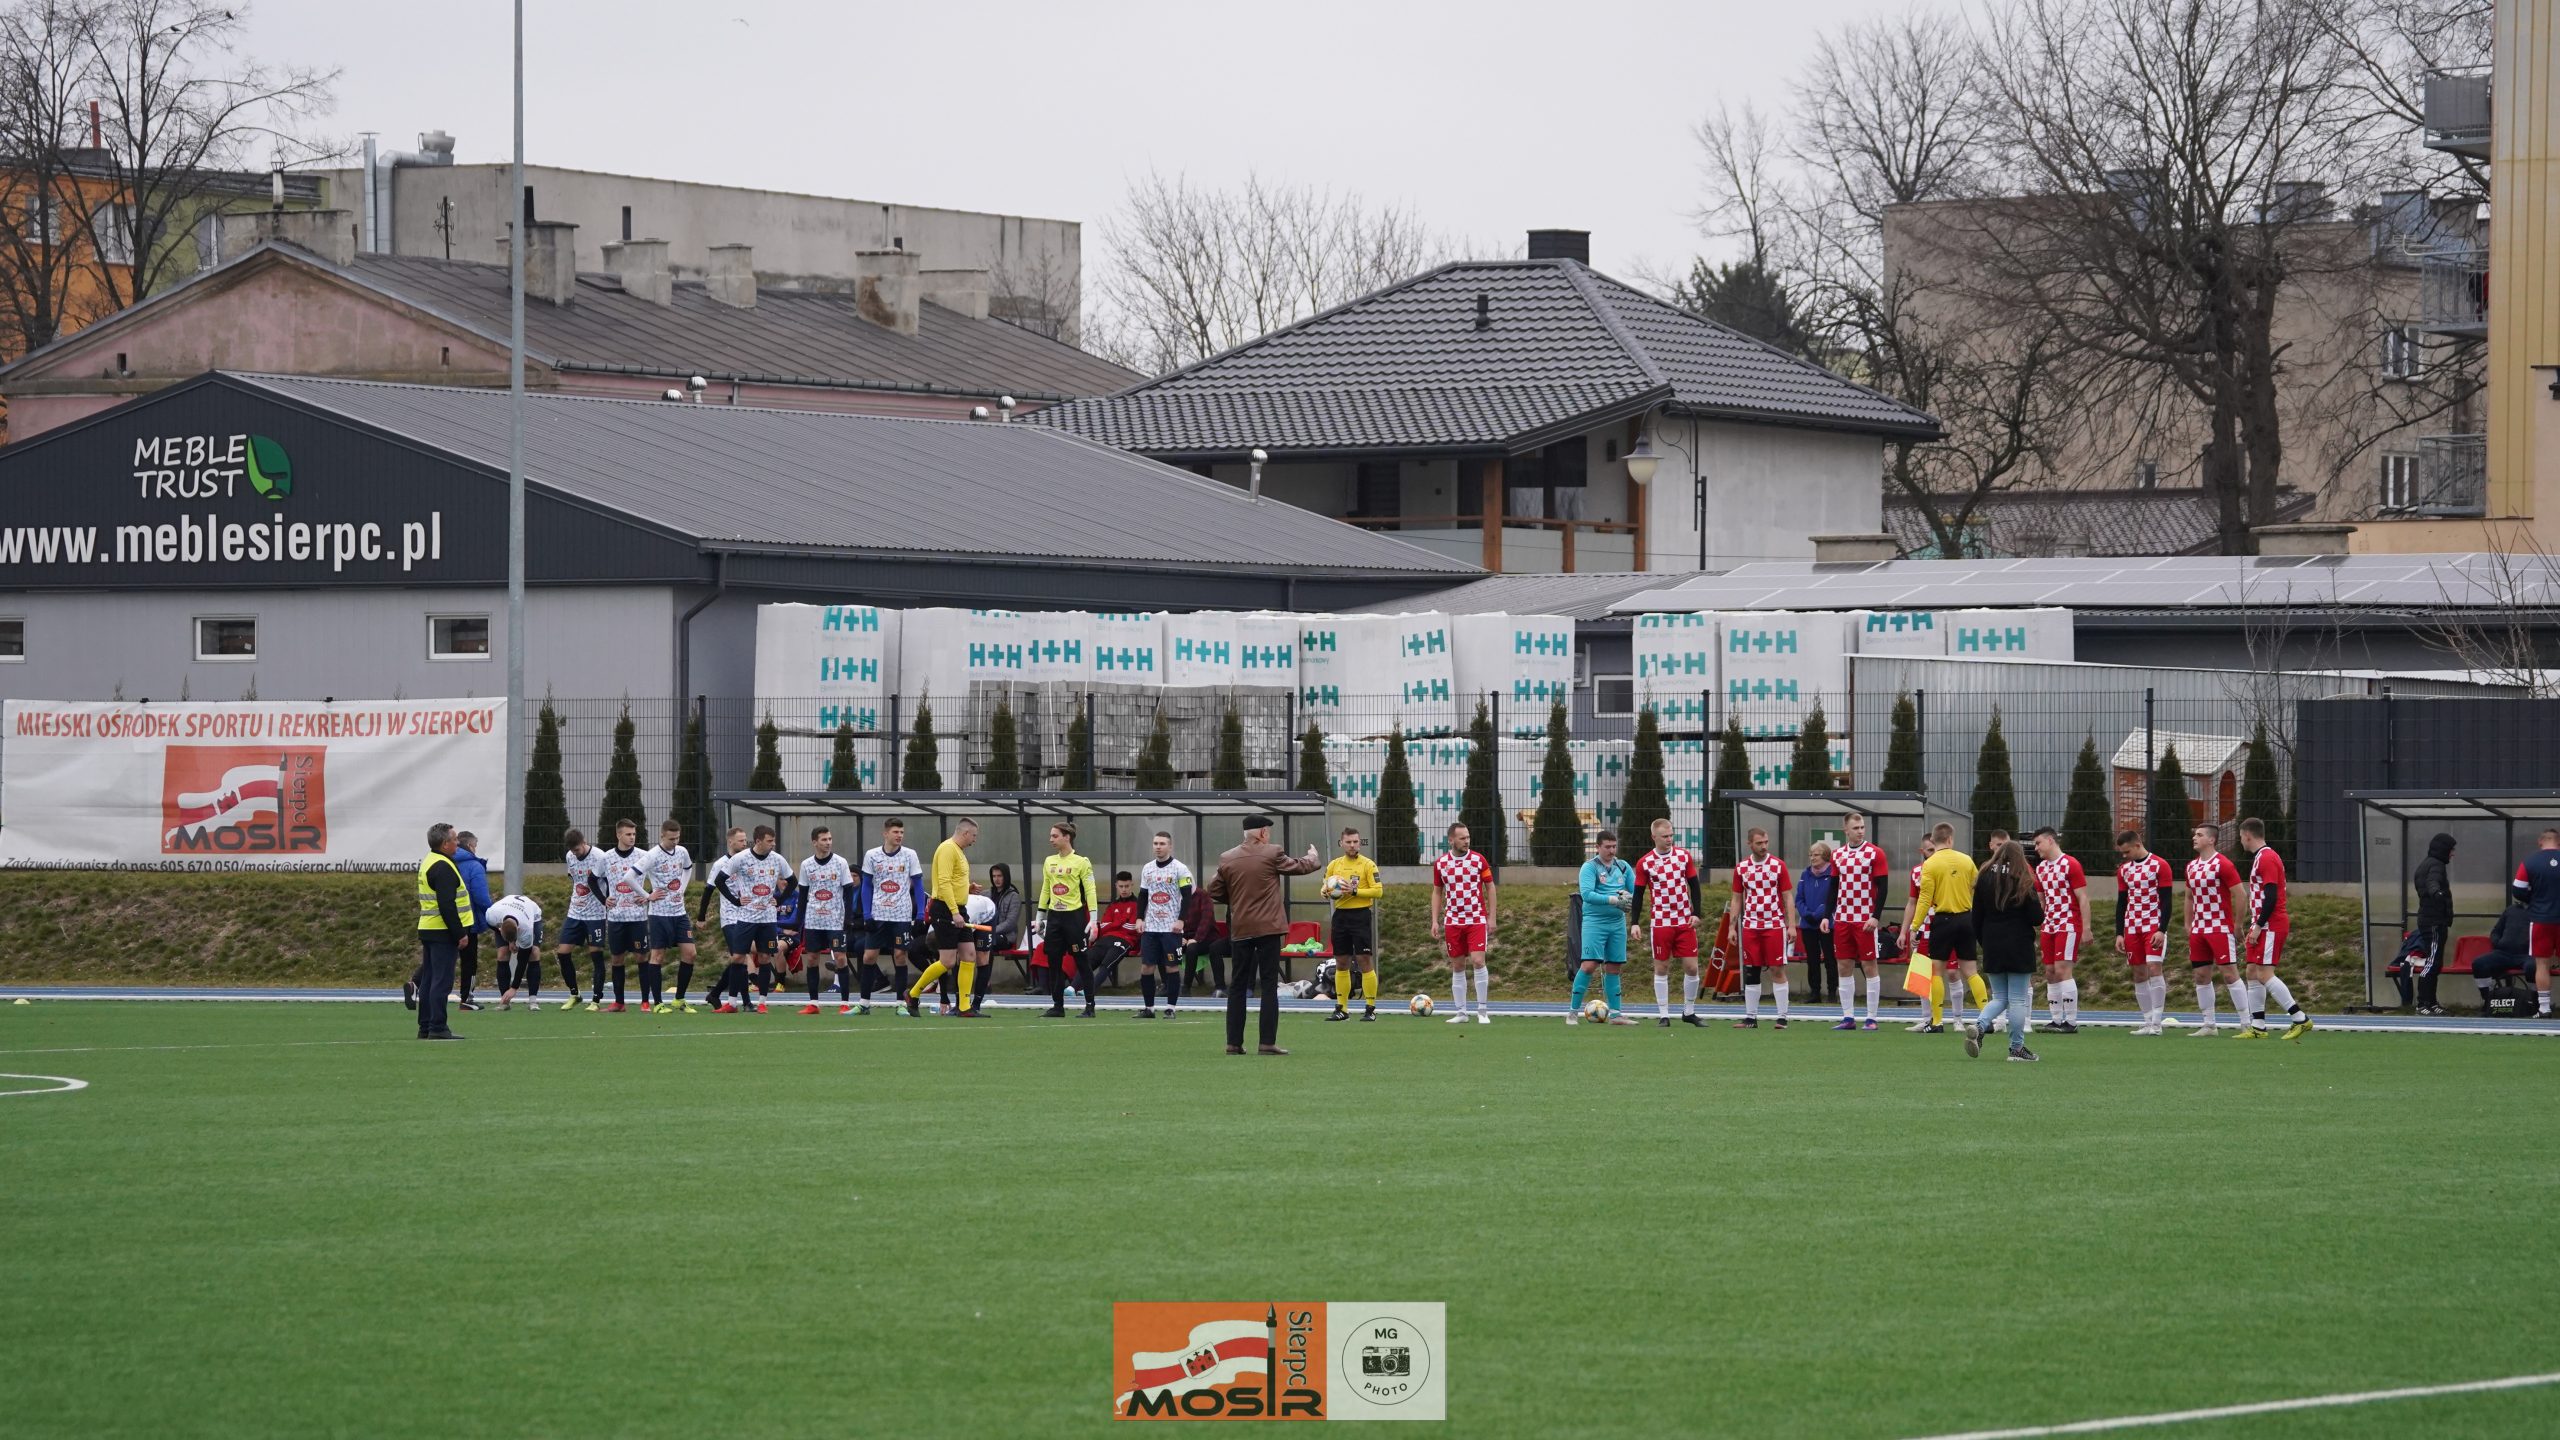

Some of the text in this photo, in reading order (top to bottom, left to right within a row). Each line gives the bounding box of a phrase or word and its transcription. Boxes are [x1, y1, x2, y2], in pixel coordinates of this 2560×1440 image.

[133, 433, 248, 467] MEBLE
[133, 469, 244, 499] TRUST
[0, 511, 441, 572] www.meblesierpc.pl
[822, 607, 879, 632] H+H
[1867, 612, 1933, 633] H+H
[1176, 637, 1230, 664] H+H
[1515, 630, 1567, 656] H+H
[1729, 629, 1797, 654] H+H
[1958, 627, 2025, 652] H+H
[970, 642, 1022, 669] H+H
[1095, 646, 1153, 671] H+H
[1242, 645, 1292, 668] H+H
[1514, 679, 1566, 704] H+H
[1730, 678, 1798, 703] H+H
[16, 709, 494, 738] MIEJSKI OŚRODEK SPORTU I REKREACJI W SIERPCU
[820, 705, 876, 730] H+H
[289, 756, 313, 823] Sierpc
[160, 860, 185, 872] 605
[190, 860, 213, 872] 670
[2490, 998, 2516, 1008] SELECT
